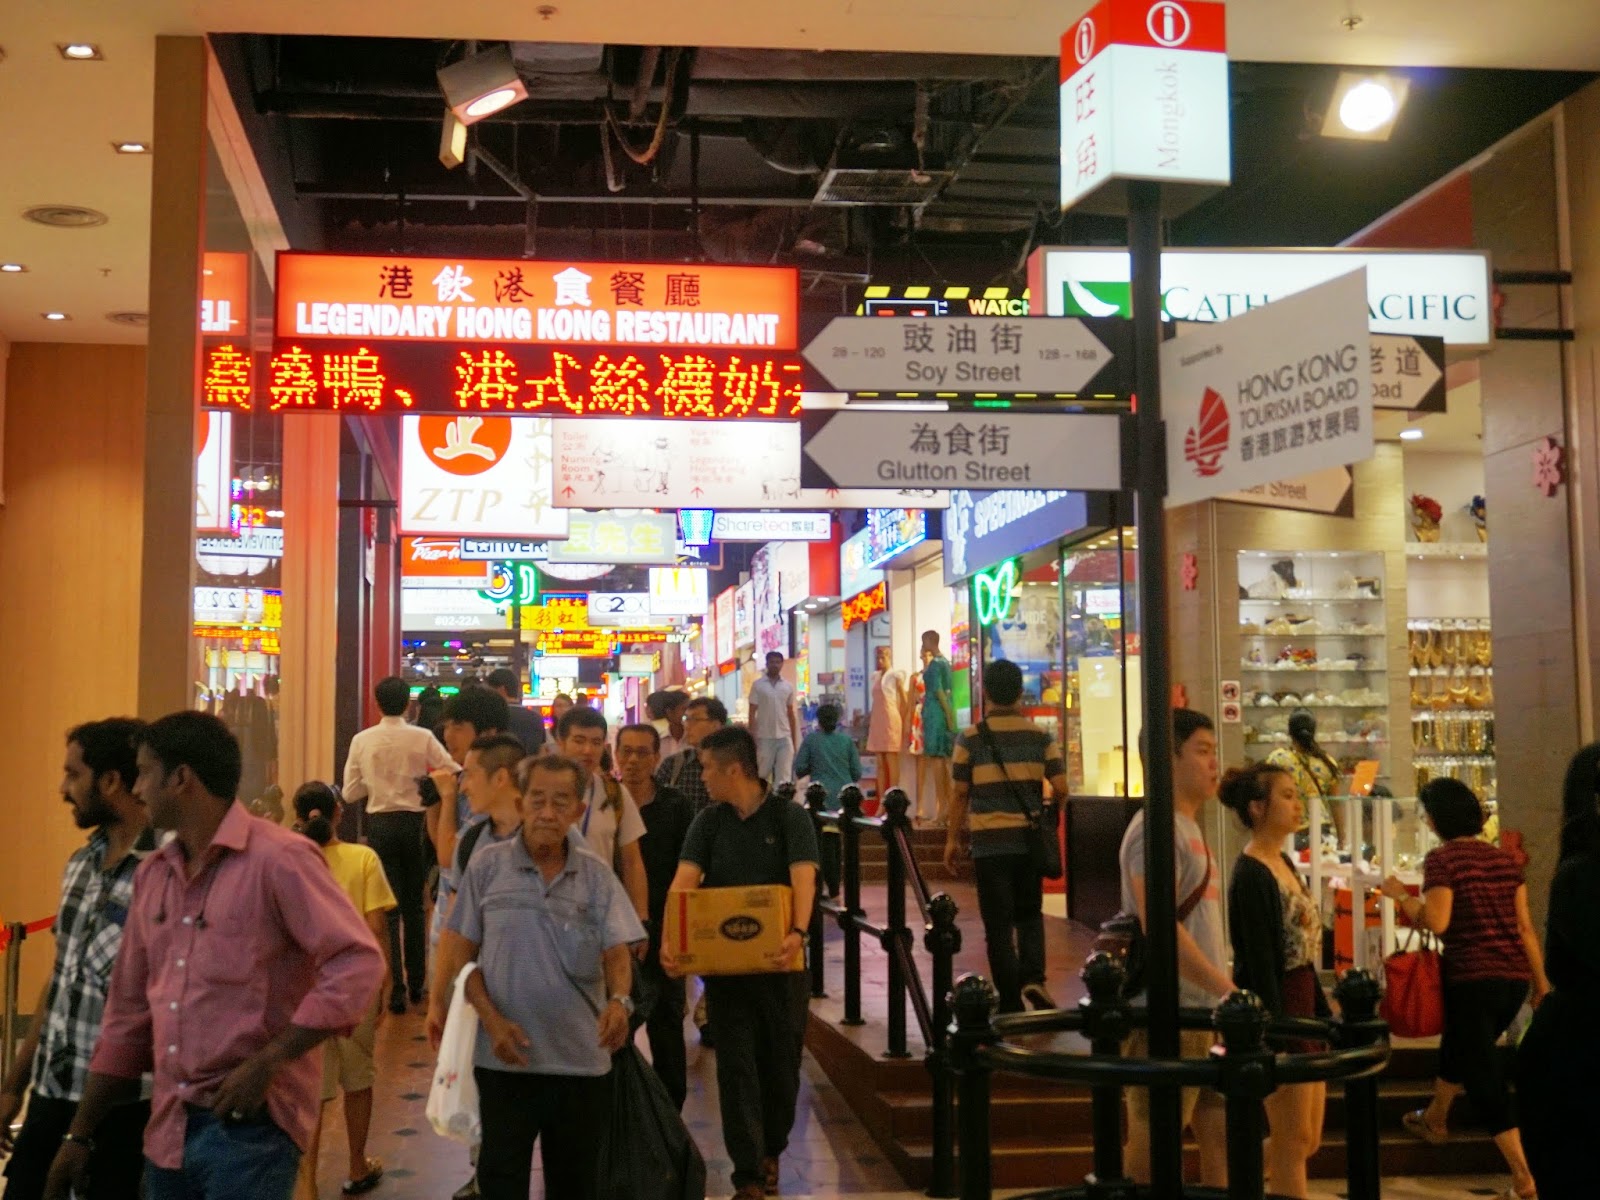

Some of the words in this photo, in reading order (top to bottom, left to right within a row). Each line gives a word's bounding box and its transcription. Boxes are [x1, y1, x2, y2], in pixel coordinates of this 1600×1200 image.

[1155, 58, 1184, 170] Mongkok
[296, 302, 453, 338] LEGENDARY
[456, 306, 531, 340] HONG
[537, 308, 611, 342] KONG
[615, 309, 780, 345] RESTAURANT
[863, 347, 886, 358] 120
[1038, 349, 1062, 361] 128
[905, 360, 949, 386] Soy
[955, 361, 1022, 382] Street
[1237, 364, 1294, 404] HONG
[1297, 343, 1358, 386] KONG
[1239, 398, 1300, 431] TOURISM
[1303, 377, 1359, 413] BOARD
[909, 422, 1011, 456] 為食街
[561, 463, 591, 473] Room
[876, 459, 957, 482] Glutton
[964, 461, 1032, 482] Street
[1270, 481, 1308, 501] Street
[411, 487, 503, 523] ZTP
[716, 516, 790, 533] Sharetea
